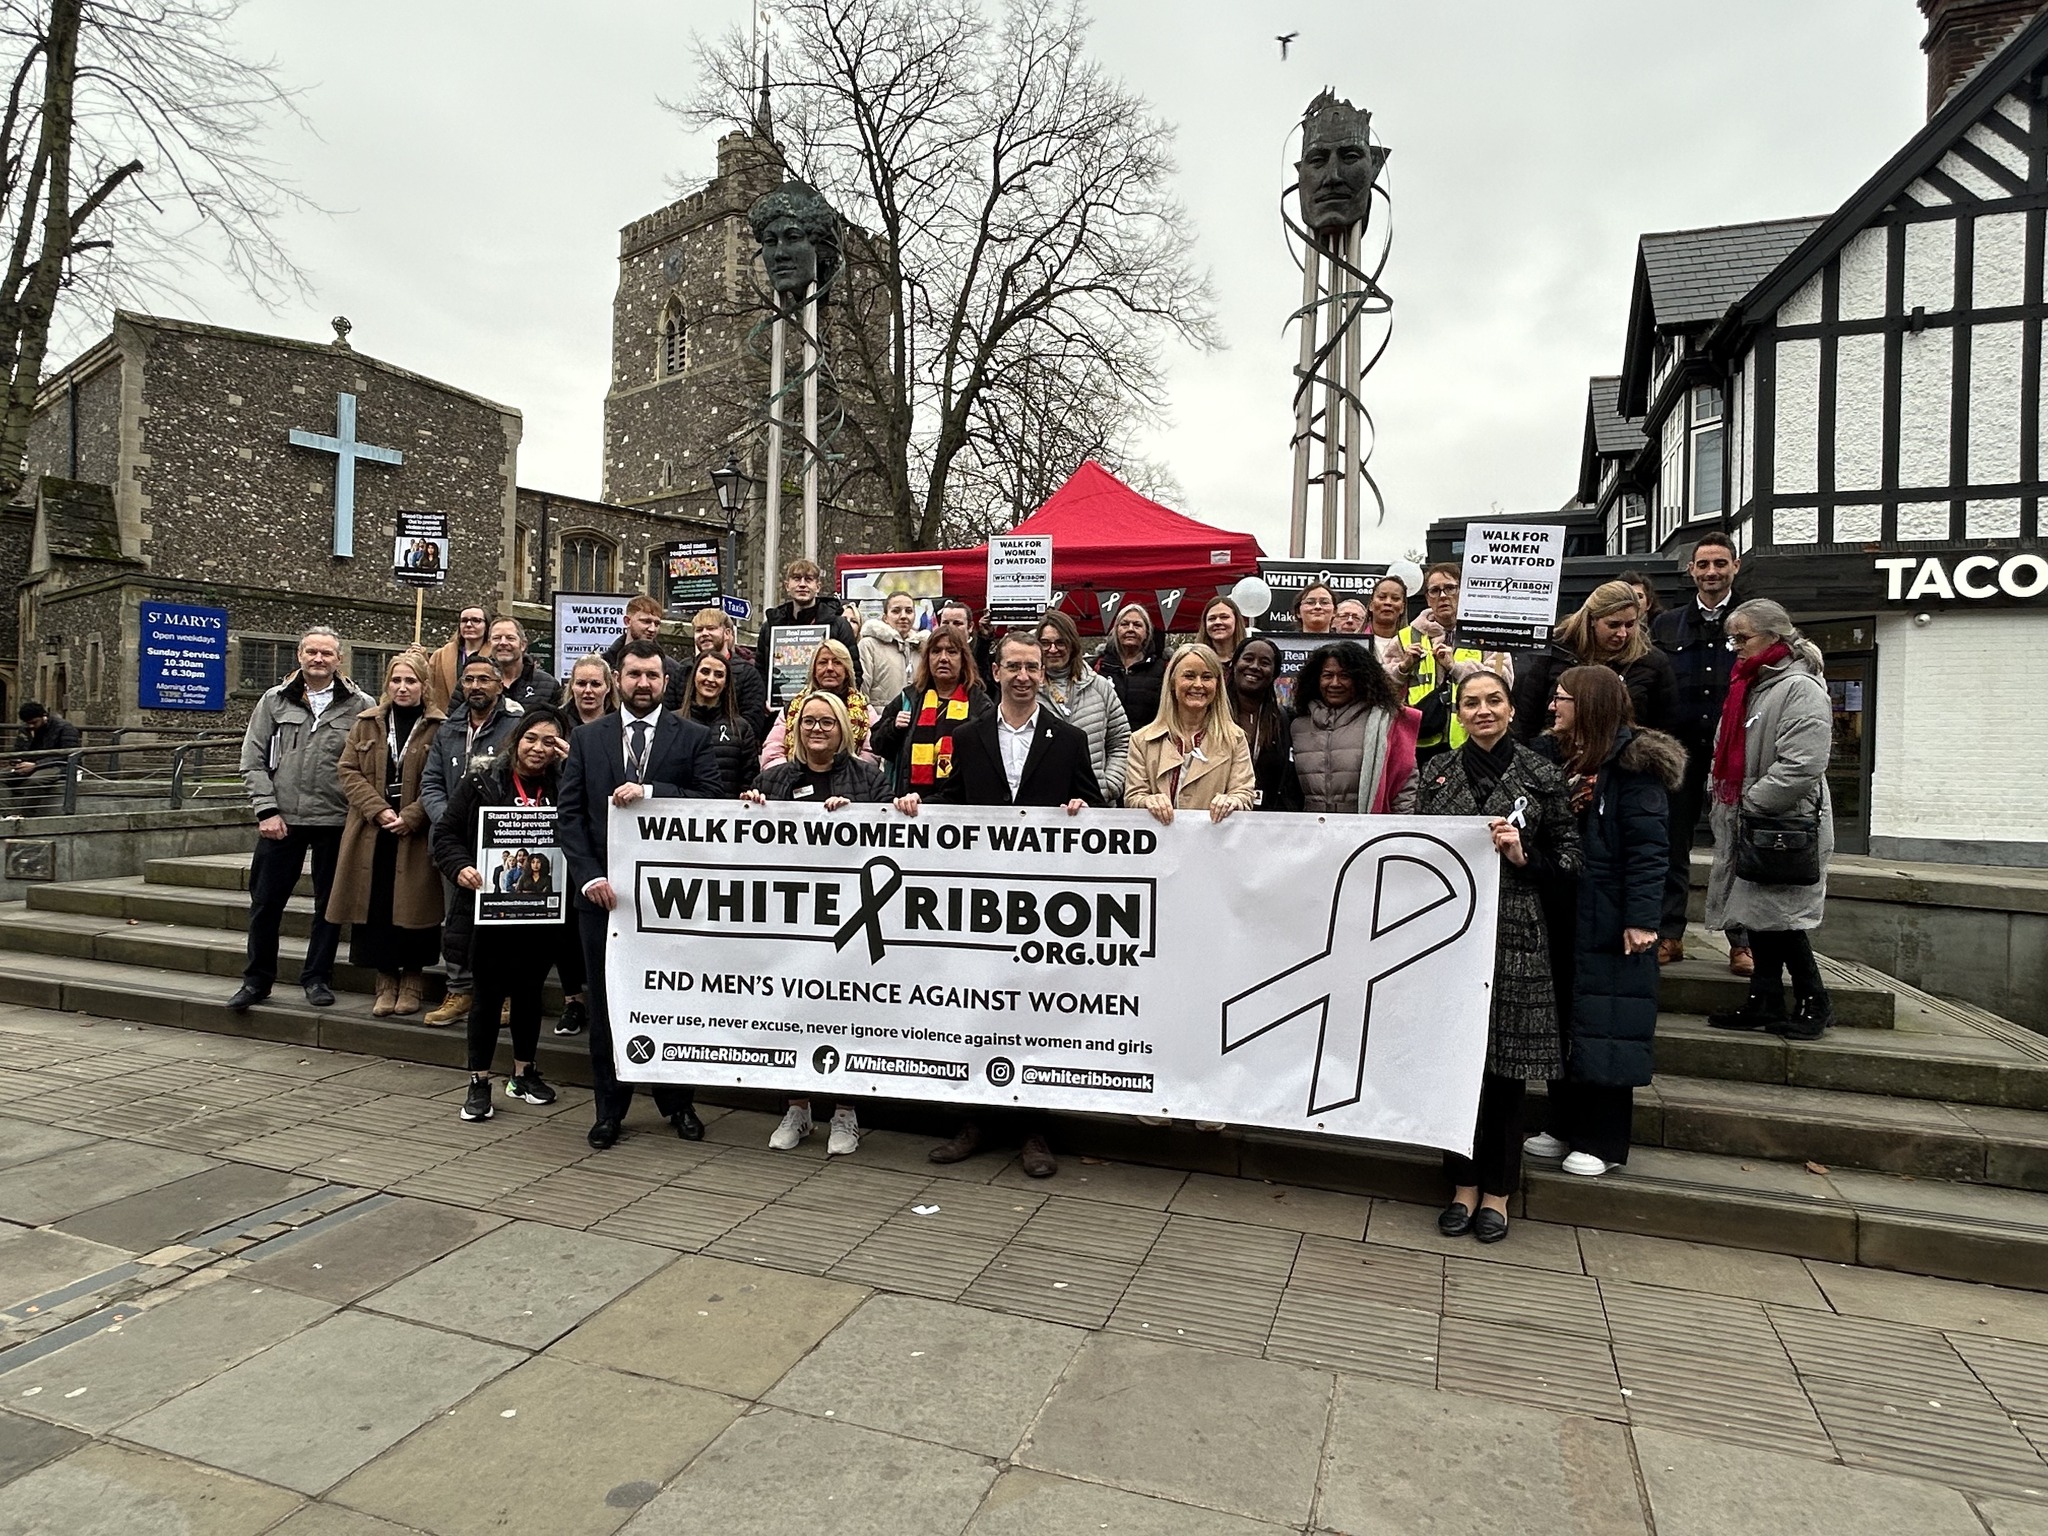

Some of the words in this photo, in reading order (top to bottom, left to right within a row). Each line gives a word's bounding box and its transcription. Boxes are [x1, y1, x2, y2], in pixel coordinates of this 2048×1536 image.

[1482, 530, 1520, 541] WALK
[1522, 532, 1549, 542] FOR
[1489, 544, 1540, 554] WOMEN
[1470, 555, 1488, 564] OF
[1490, 555, 1555, 567] WATFORD
[1266, 574, 1316, 587] WHITE
[1875, 554, 2048, 600] TACO
[1470, 580, 1502, 588] WHITE
[1512, 582, 1550, 590] RIBBON
[572, 606, 602, 614] WALK
[603, 607, 624, 615] FOR
[728, 601, 744, 614] Taxis
[164, 613, 221, 629] MARY'S
[578, 616, 618, 624] WOMEN
[152, 631, 175, 640] Open
[176, 634, 215, 644] weekdays
[147, 647, 180, 658] Sunday
[182, 650, 220, 660] Services
[1284, 651, 1308, 660] Real
[164, 659, 204, 668] 10.30am
[171, 669, 205, 678] 6.30pm
[156, 683, 186, 692] Morning
[187, 684, 210, 692] Coffee
[521, 820, 550, 829] prevent
[527, 829, 554, 837] against
[637, 816, 728, 843] WALK
[734, 819, 799, 845] FOR
[803, 821, 929, 849] WOMEN
[936, 824, 980, 850] OF
[987, 826, 1157, 855] WATFORD
[538, 837, 554, 845] girls
[647, 877, 841, 926] WHITE
[905, 886, 1140, 938] RIBBON
[1013, 940, 1140, 967] .ORG.UK
[644, 970, 694, 991] END
[701, 973, 773, 996] MEN'S
[781, 978, 901, 1003] VIOLENCE
[909, 984, 1021, 1011] AGAINST
[1028, 991, 1139, 1017] WOMEN
[629, 1011, 673, 1026] Never
[676, 1015, 705, 1028] use,
[708, 1017, 748, 1029] never
[751, 1020, 803, 1035] excuse,
[806, 1023, 847, 1035] never
[851, 1023, 898, 1039] ignore
[901, 1027, 961, 1044] violence
[964, 1033, 1022, 1048] against
[1025, 1036, 1081, 1050] women
[1085, 1039, 1114, 1052] and
[1118, 1041, 1153, 1055] girls
[663, 1046, 796, 1066] @WhiteRibbon_UK
[846, 1054, 968, 1078] /WhiteRibbonUK
[1023, 1067, 1152, 1090] @whiteribbonuk
